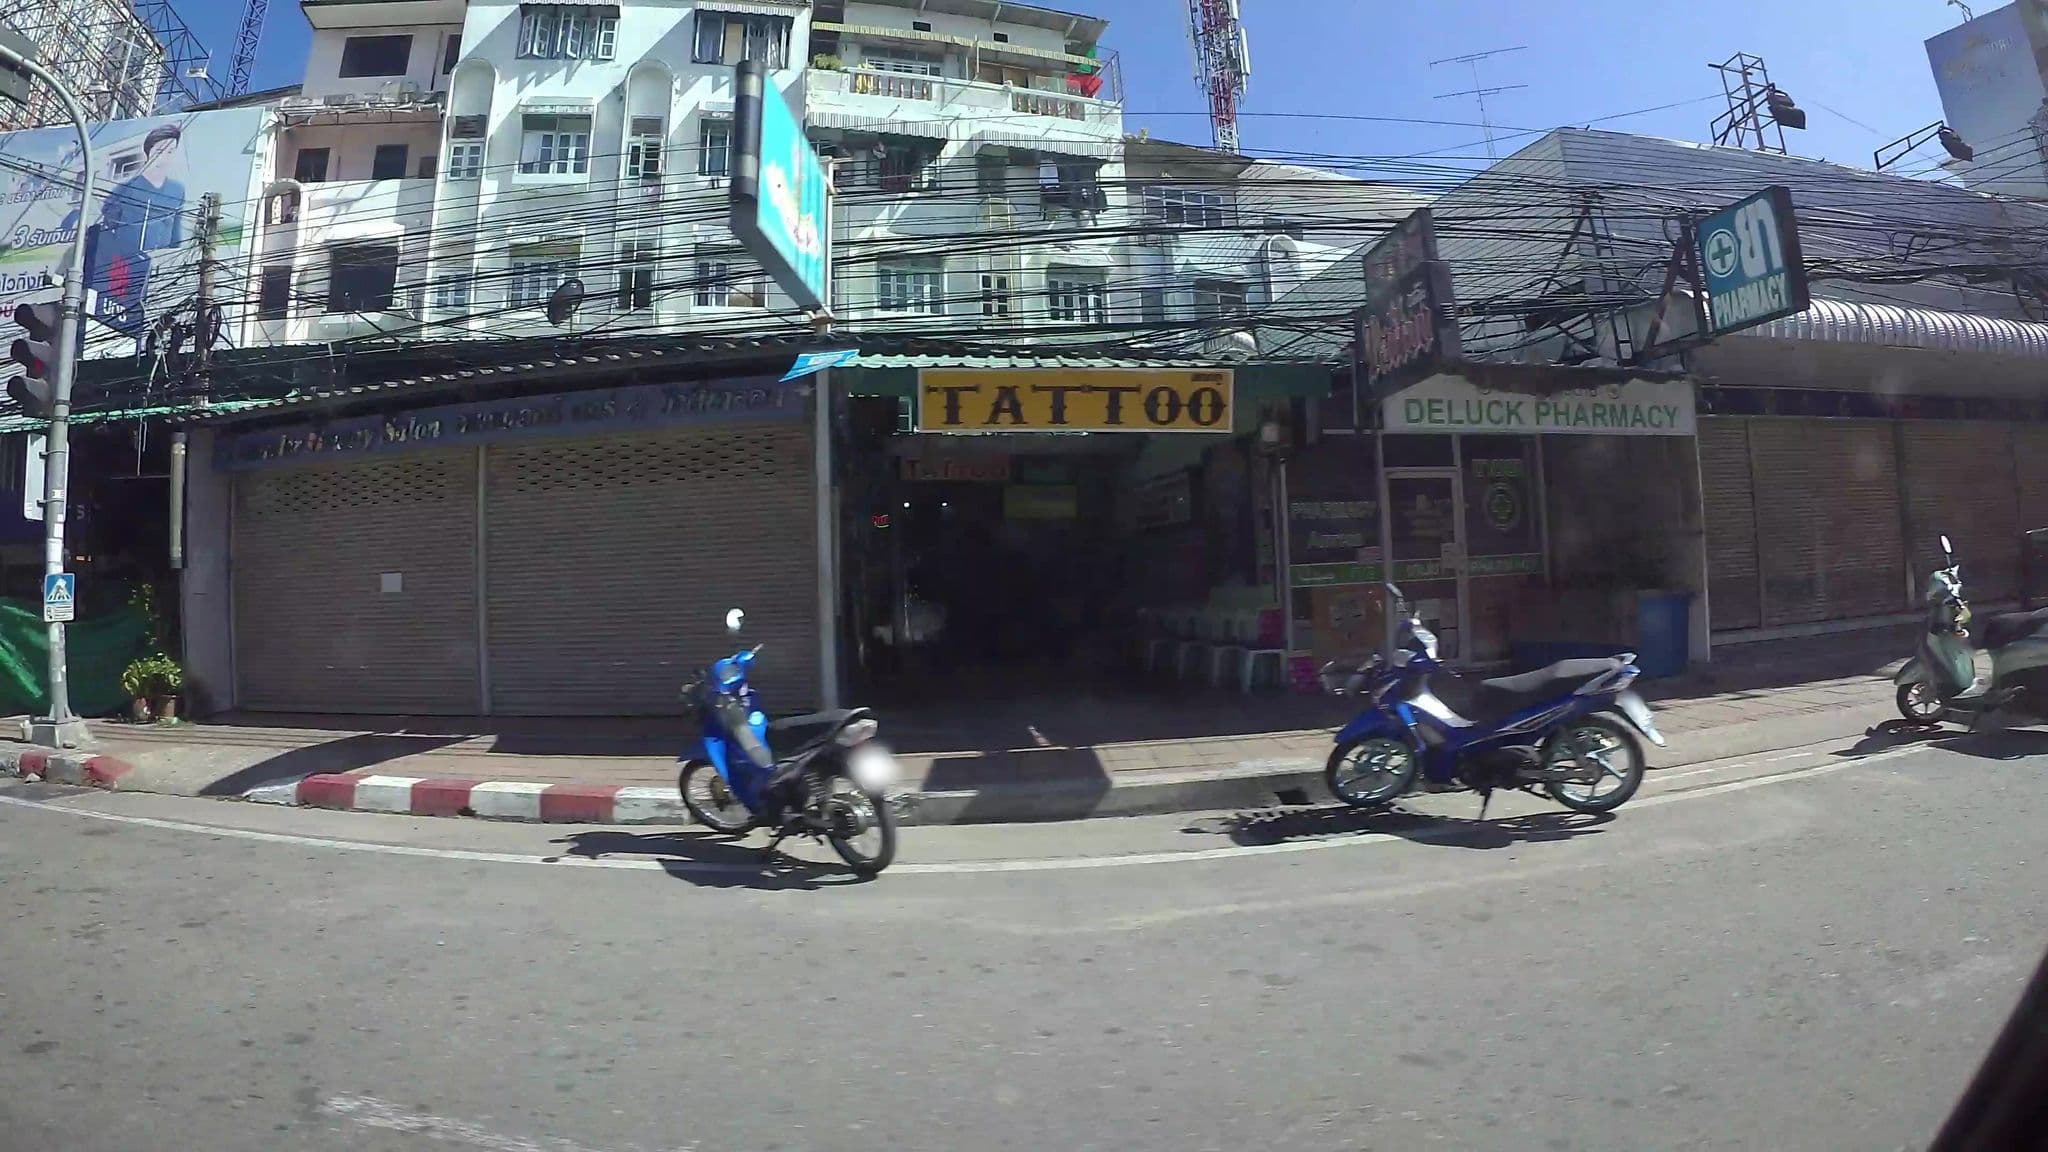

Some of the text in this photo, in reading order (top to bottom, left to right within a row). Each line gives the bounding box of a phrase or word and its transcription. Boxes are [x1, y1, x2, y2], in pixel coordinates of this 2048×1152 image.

[1735, 199, 1783, 278] ยา
[1713, 272, 1787, 330] PHARMACY
[925, 385, 1227, 426] TATTOO
[1404, 398, 1679, 429] DELUCK PHARMACY
